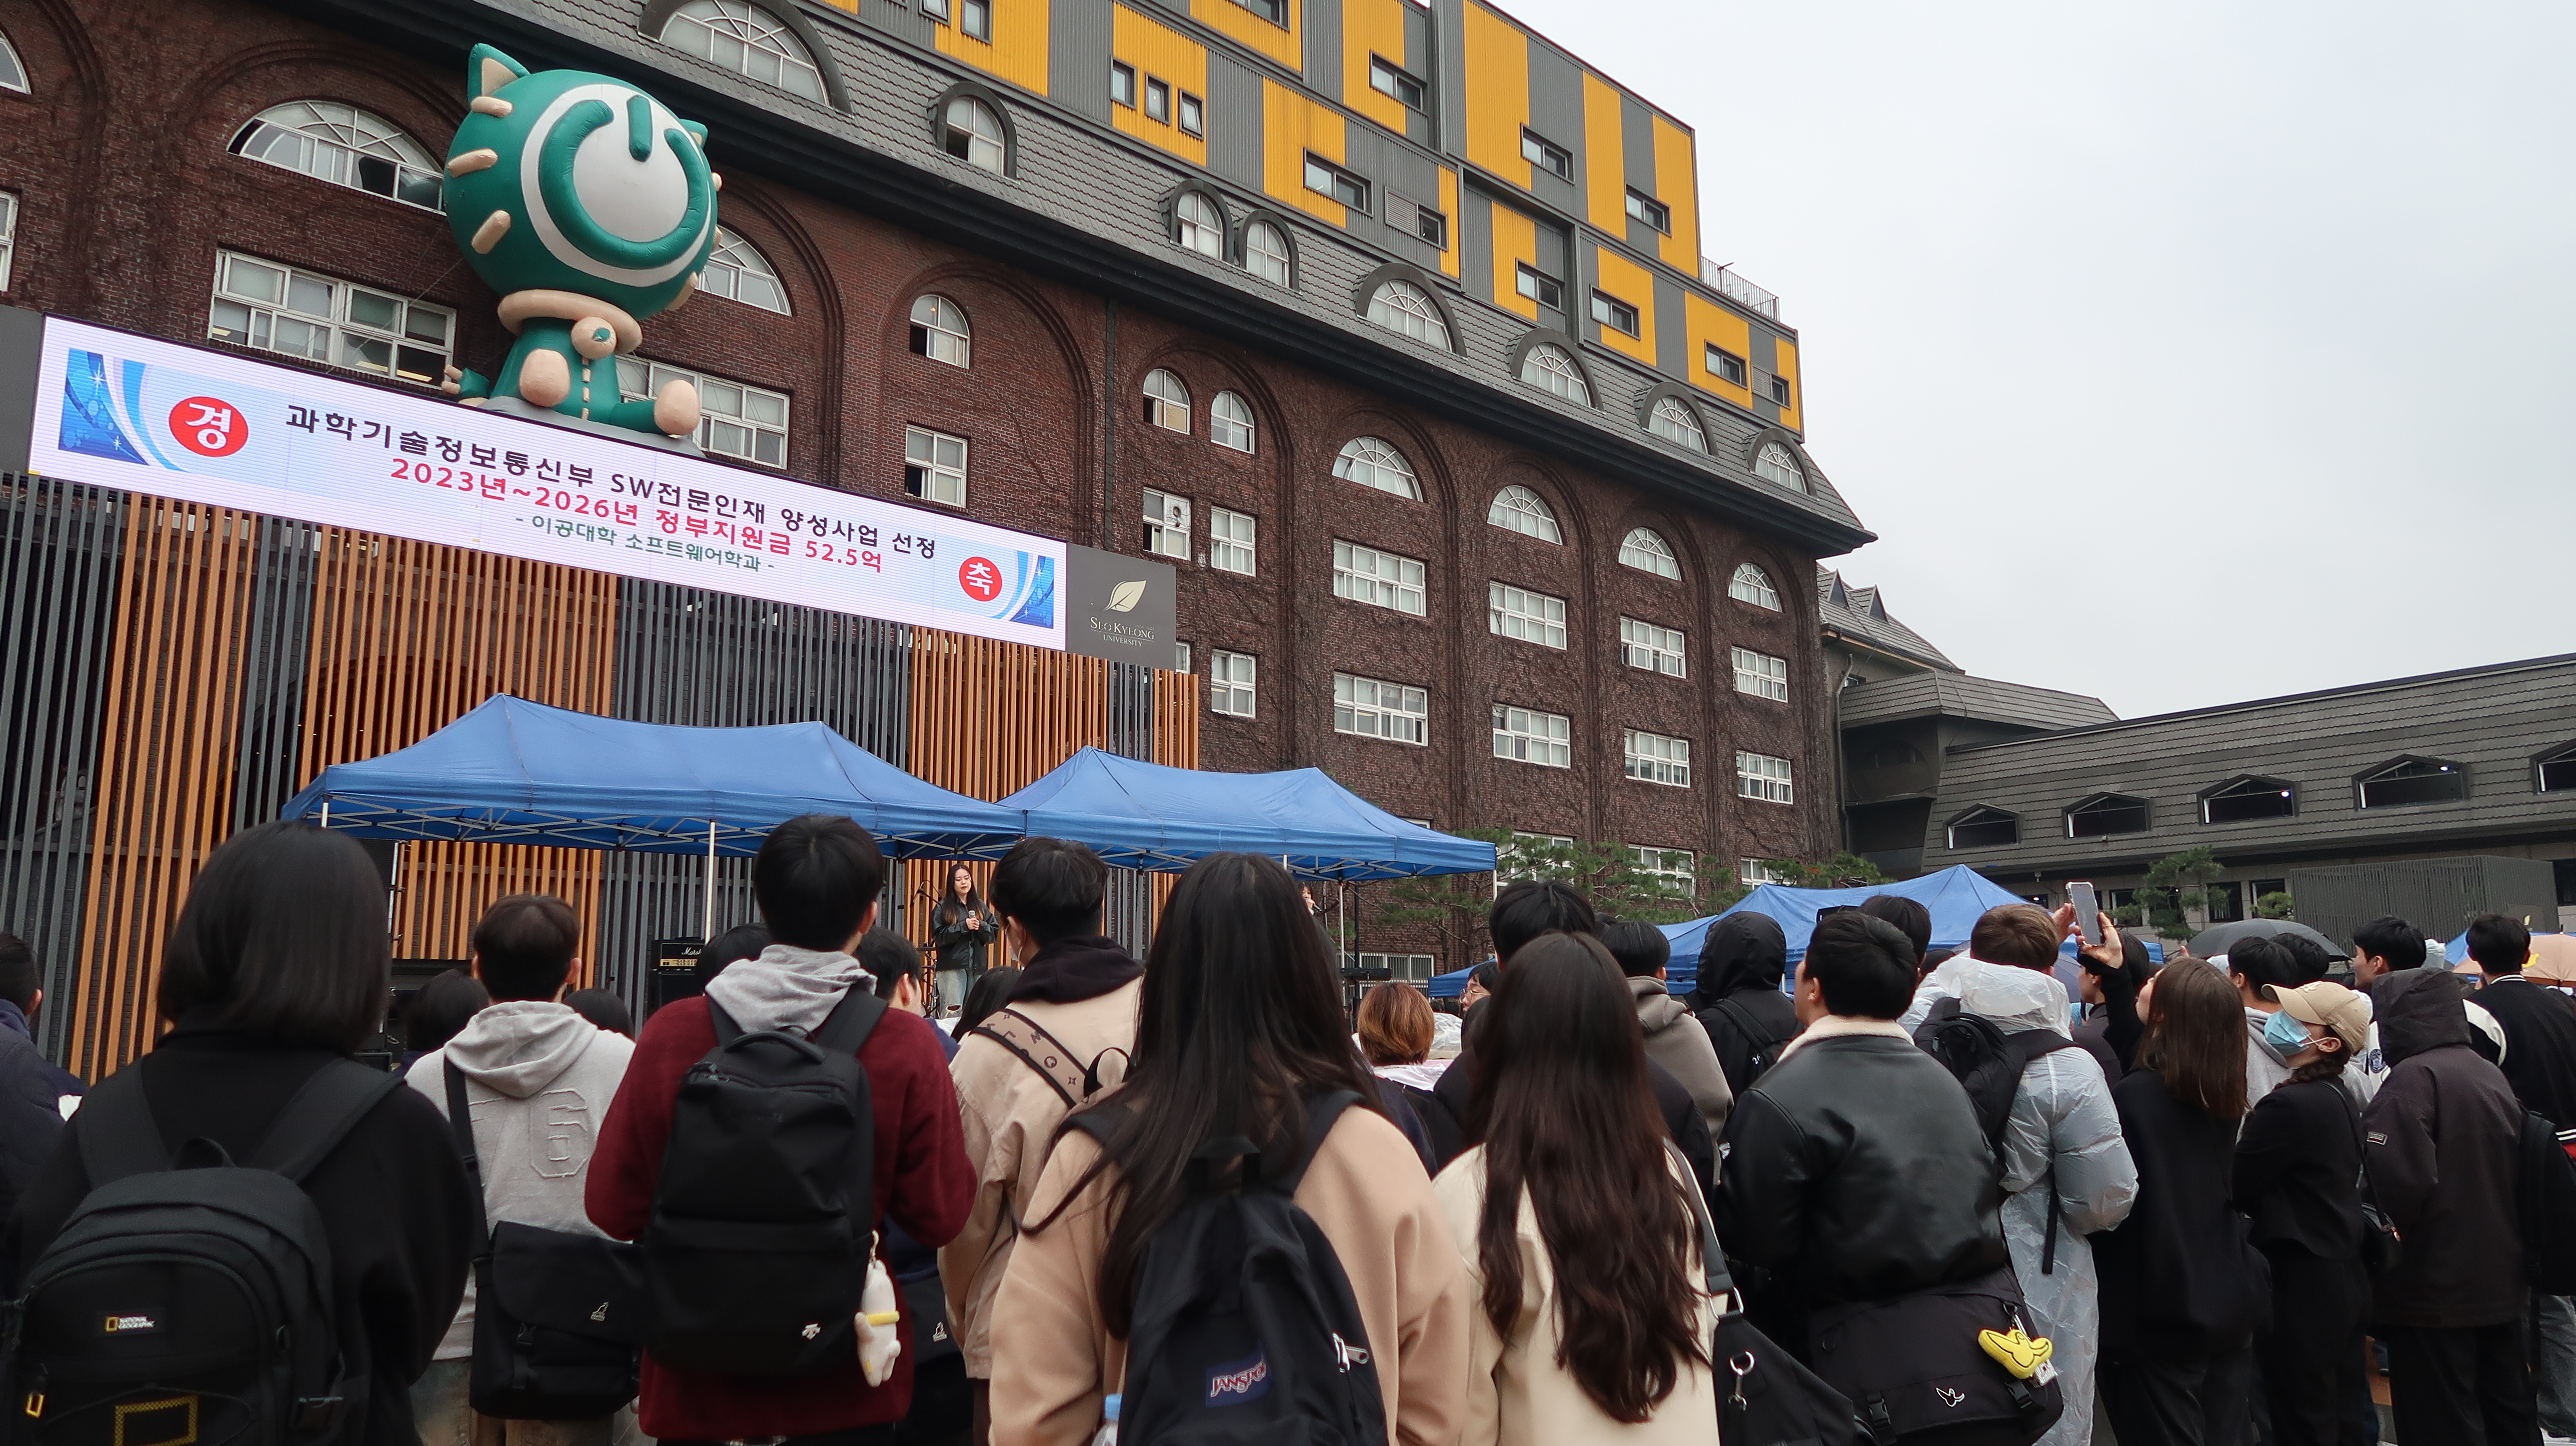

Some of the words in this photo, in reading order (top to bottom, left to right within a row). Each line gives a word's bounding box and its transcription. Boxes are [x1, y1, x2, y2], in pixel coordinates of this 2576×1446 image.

[185, 402, 232, 450] 경
[286, 405, 593, 488] 과학기술정보통신부
[611, 474, 765, 524] SW전문인재
[781, 508, 877, 547] 양성사업
[893, 533, 935, 559] 선정
[391, 458, 637, 526] 2023년~2026년
[656, 509, 790, 555] 정부지원금
[805, 540, 881, 573] 52.5억
[532, 515, 617, 546] 이공대학
[625, 534, 761, 572] 소프트웨어학과
[966, 562, 994, 595] 축
[1103, 634, 1143, 647] UNIVERSITY
[1210, 1358, 1266, 1397] JANSPO
